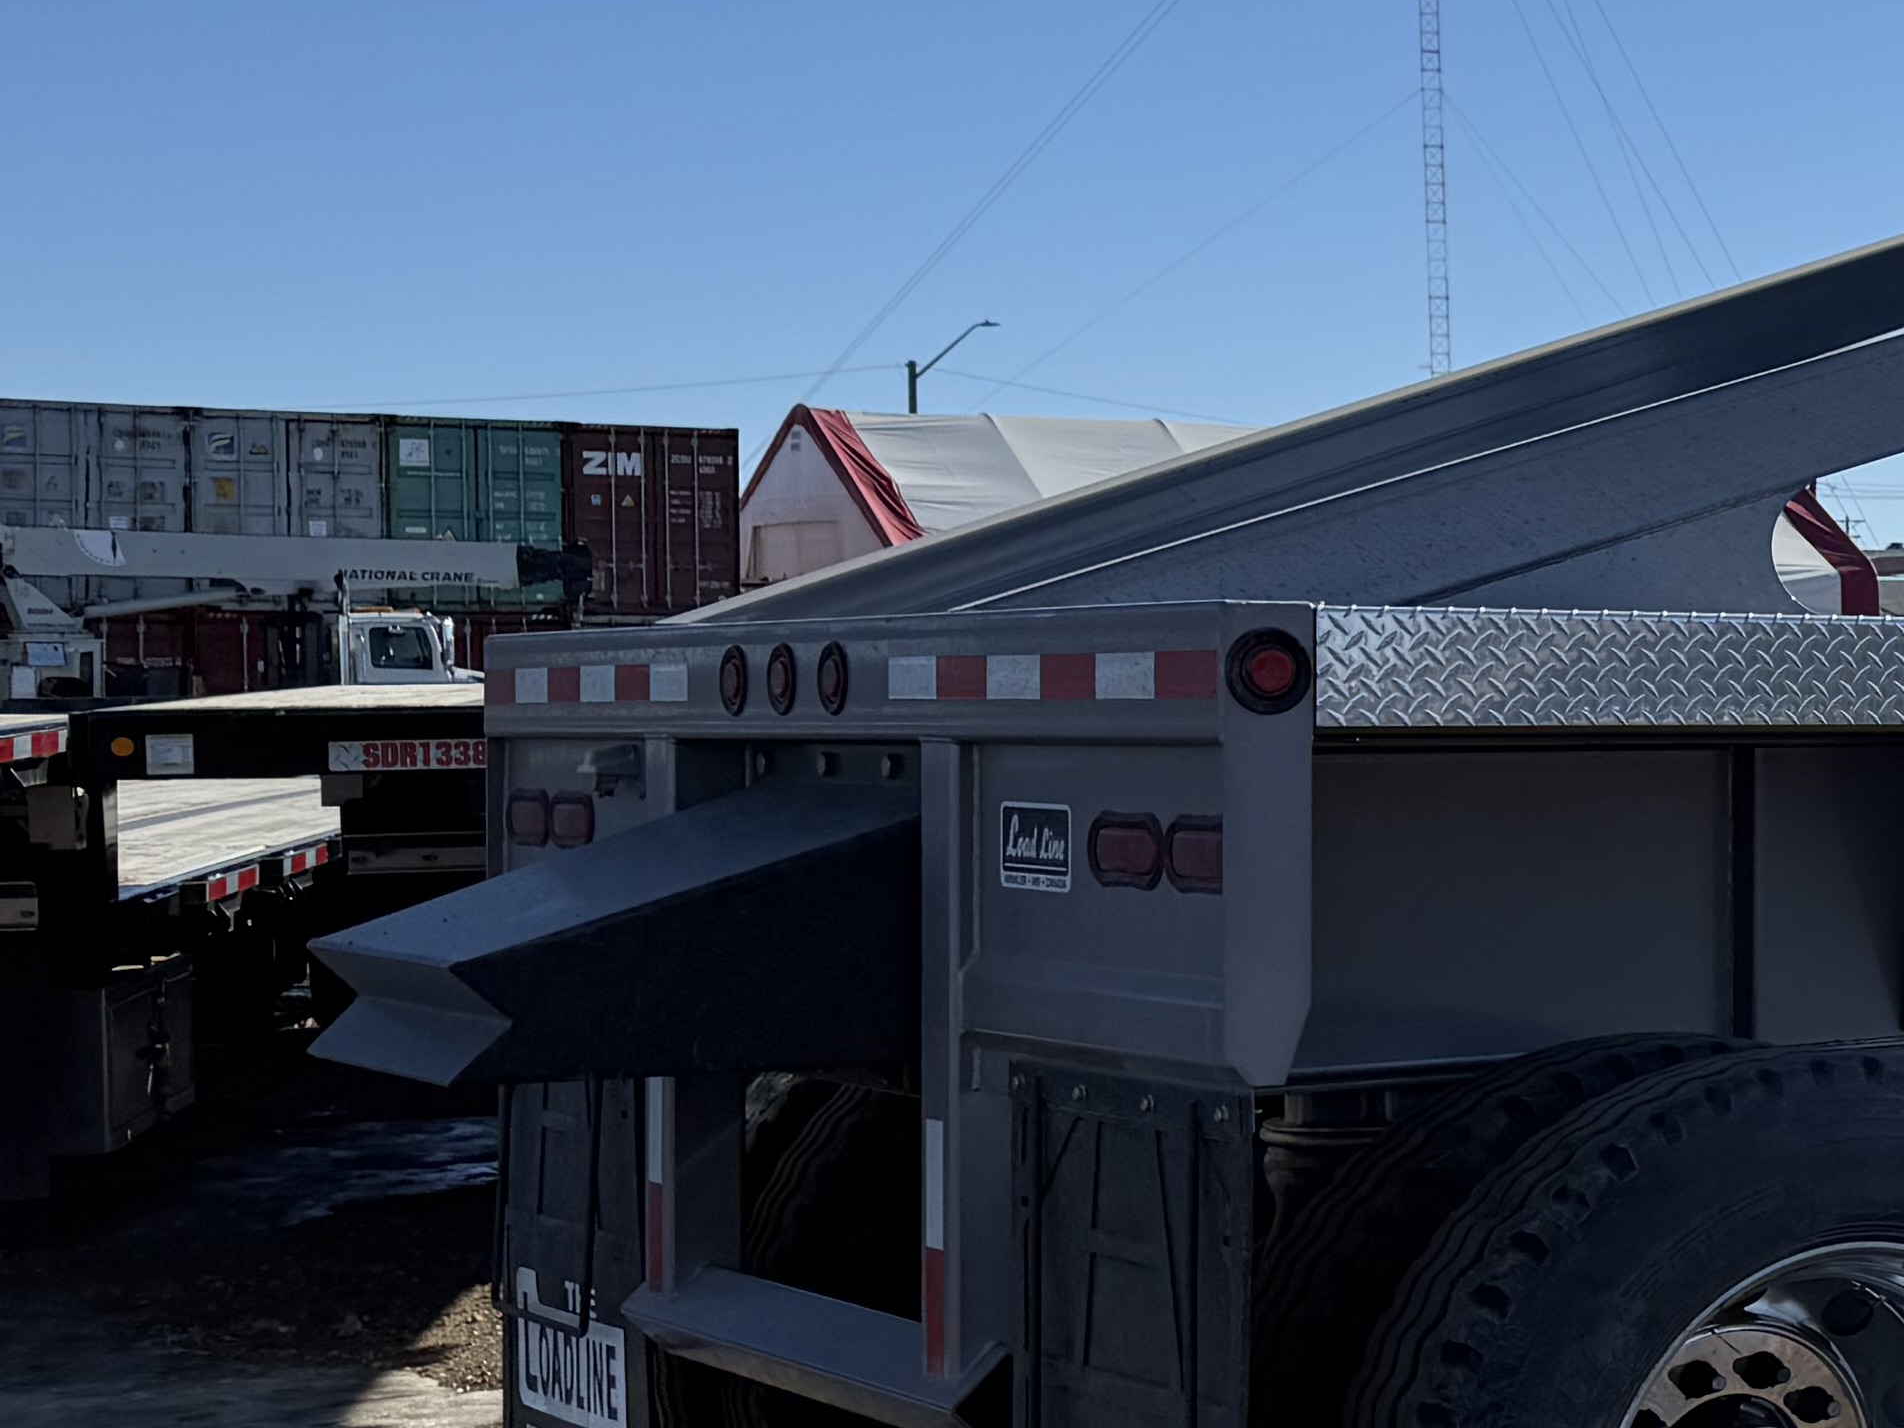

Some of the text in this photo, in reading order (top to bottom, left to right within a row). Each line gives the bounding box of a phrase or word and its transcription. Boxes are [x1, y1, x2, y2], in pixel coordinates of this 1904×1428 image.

[582, 450, 642, 476] ZIM
[421, 571, 475, 583] CRANE
[1006, 814, 1065, 861] Load Line
[523, 1291, 618, 1421] LOADLINE
